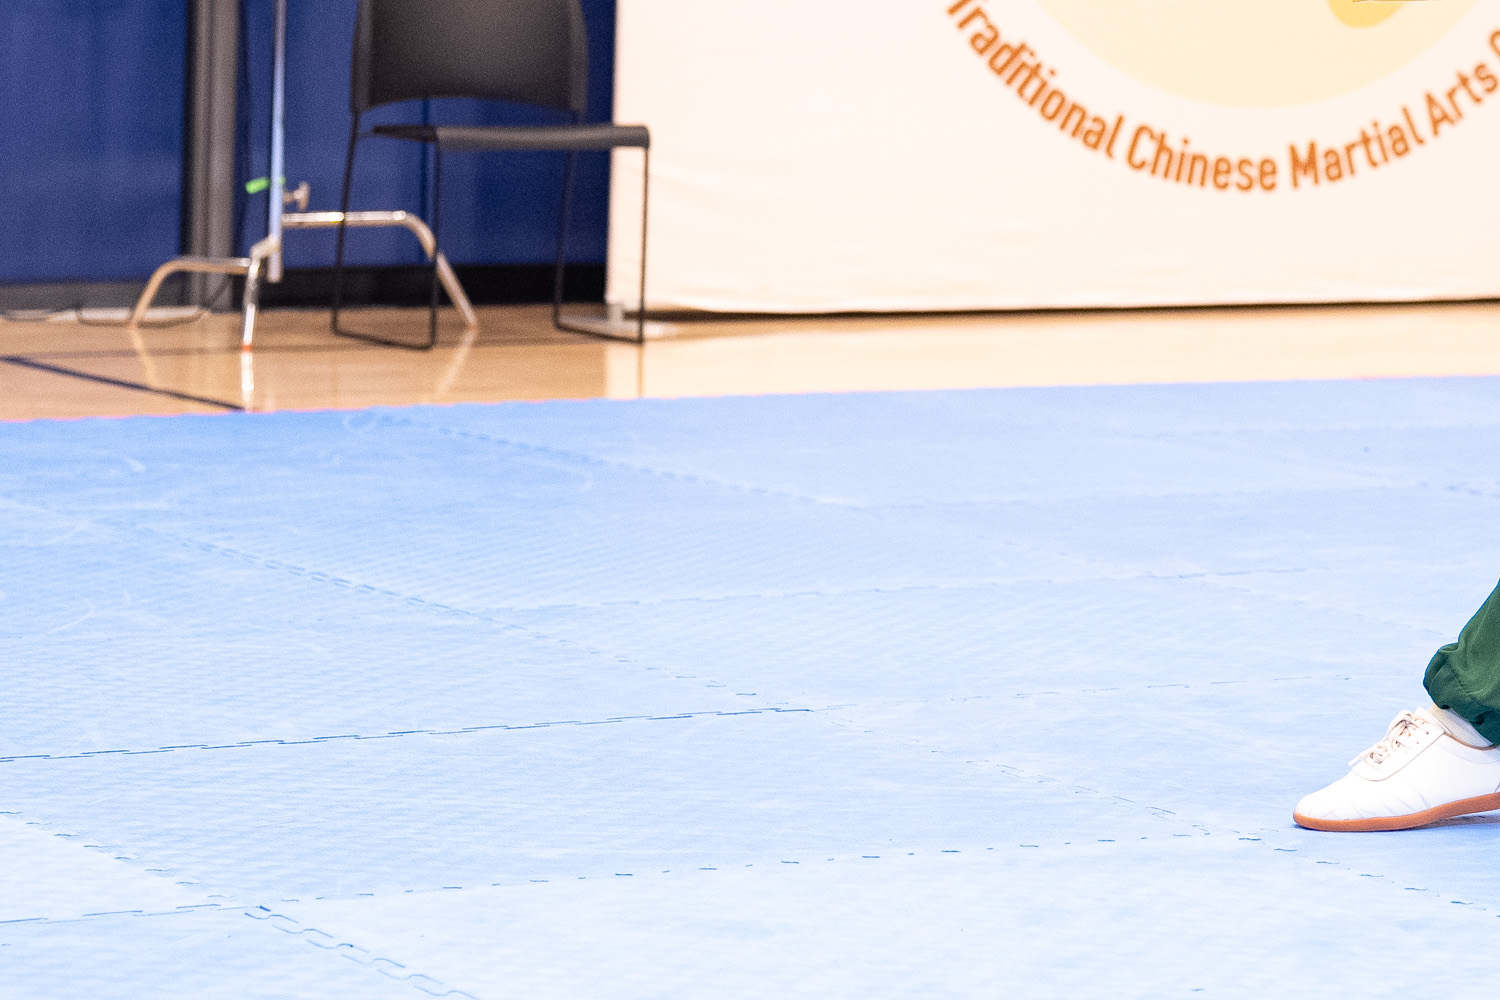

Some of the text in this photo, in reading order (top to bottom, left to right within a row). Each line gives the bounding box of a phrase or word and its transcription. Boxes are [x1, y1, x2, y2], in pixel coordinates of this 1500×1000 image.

[1126, 124, 1278, 192] Chinese
[1289, 105, 1425, 188] Martial
[1424, 62, 1500, 138] Arts
